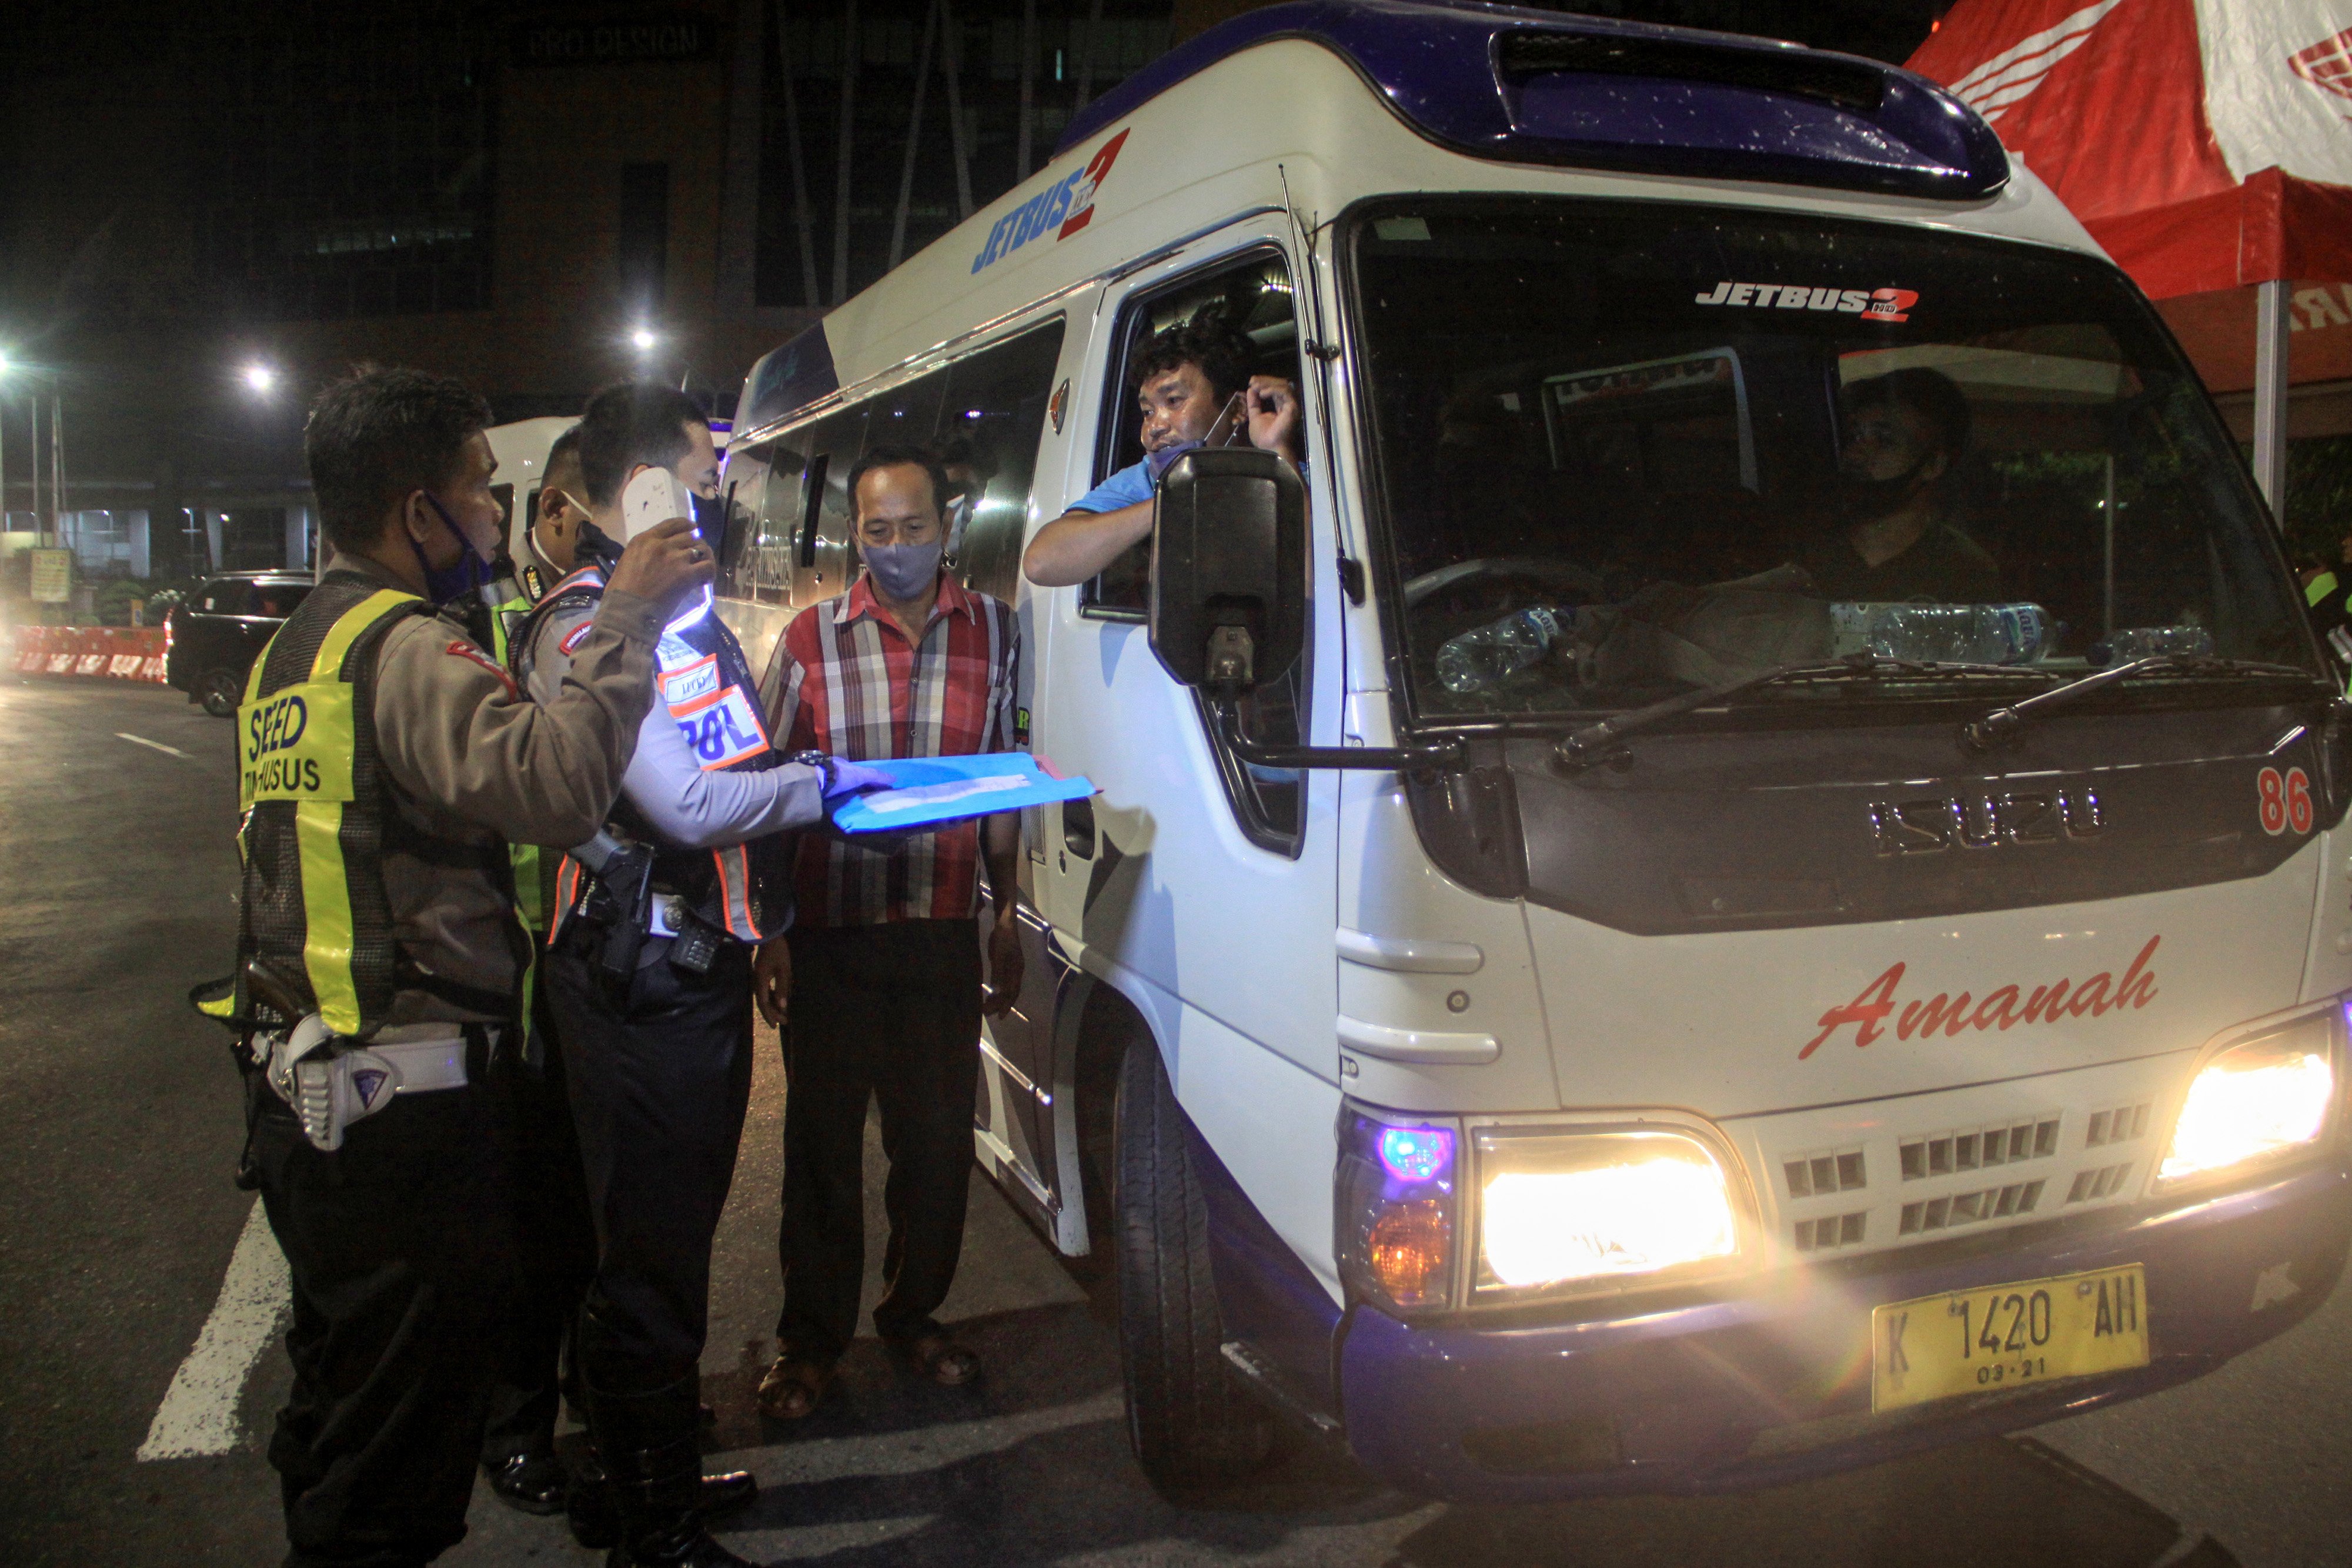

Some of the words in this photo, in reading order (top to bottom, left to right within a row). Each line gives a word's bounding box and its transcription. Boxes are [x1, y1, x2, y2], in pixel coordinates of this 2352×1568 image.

[1870, 788, 2107, 857] ISUZU
[2257, 767, 2314, 836] 86
[1798, 935, 2161, 1061] Amanah
[1889, 1312, 1909, 1373] K
[1959, 1289, 2050, 1359] 1420
[2093, 1275, 2137, 1338] AH
